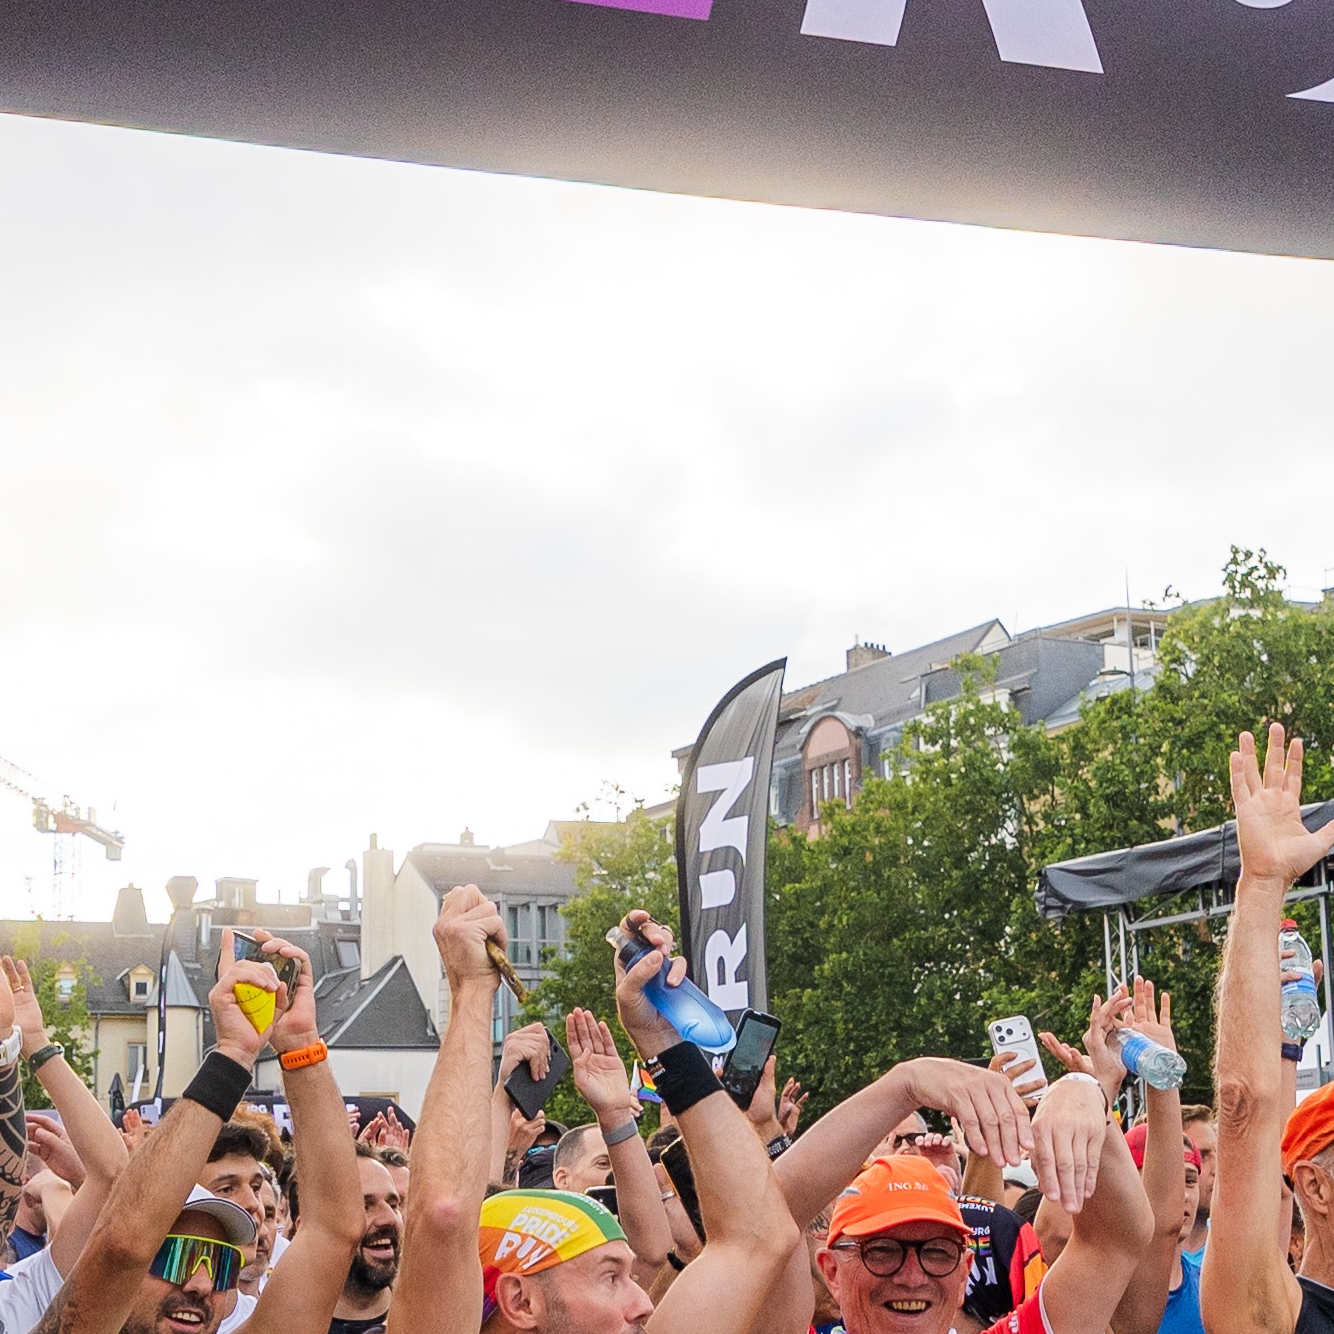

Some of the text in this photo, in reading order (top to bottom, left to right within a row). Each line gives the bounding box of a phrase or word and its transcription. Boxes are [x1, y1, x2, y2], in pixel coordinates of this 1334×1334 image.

[696, 757, 755, 1012] RUN
[888, 1182, 912, 1191] ING
[509, 1212, 570, 1248] PRIDE
